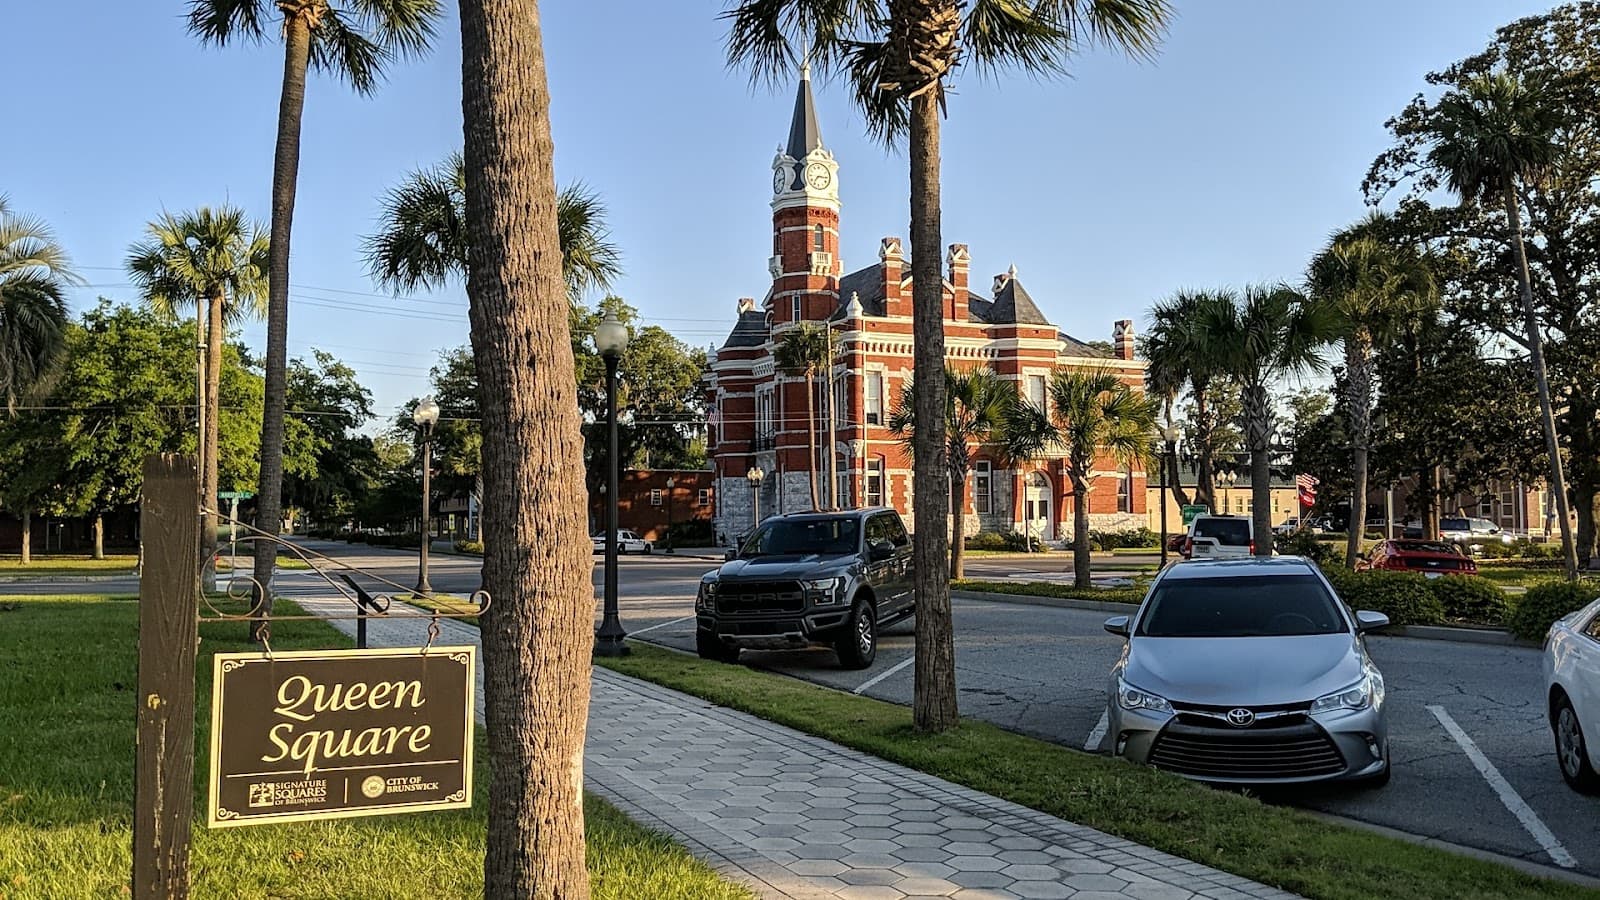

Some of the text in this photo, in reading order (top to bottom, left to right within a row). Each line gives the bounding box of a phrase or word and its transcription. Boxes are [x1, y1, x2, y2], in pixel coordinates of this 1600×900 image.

[274, 675, 426, 721] Queen
[261, 723, 431, 776] Square
[275, 779, 327, 790] SIGNATURE
[386, 776, 422, 785] CITY OF
[275, 787, 327, 800] SQUARES
[386, 782, 439, 793] BRUNSWICK
